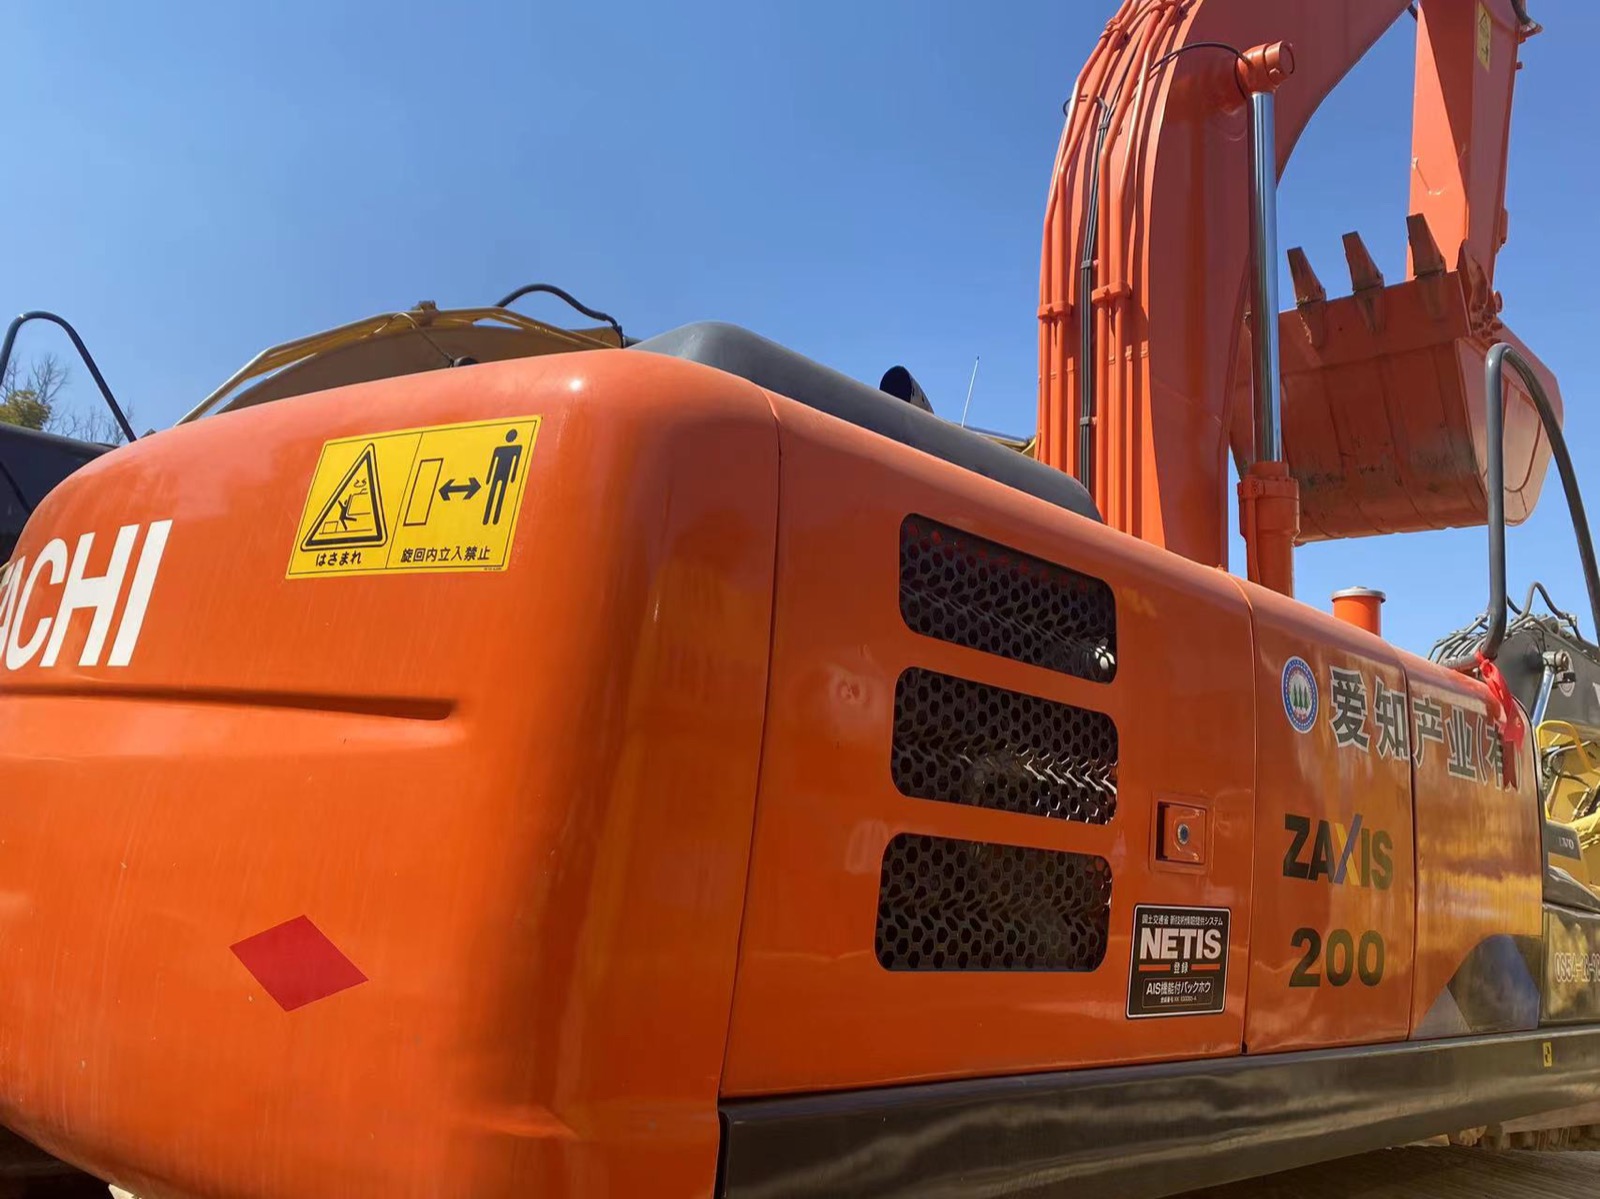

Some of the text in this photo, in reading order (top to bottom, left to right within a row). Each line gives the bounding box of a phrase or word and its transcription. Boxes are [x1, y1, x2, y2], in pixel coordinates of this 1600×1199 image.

[315, 550, 362, 566] はさまれ
[400, 546, 491, 563] 旋回内立入禁止
[1283, 813, 1393, 890] ZAXIS
[1139, 927, 1222, 960] NETIS
[1173, 962, 1189, 974] 登録
[1289, 927, 1385, 987] 200
